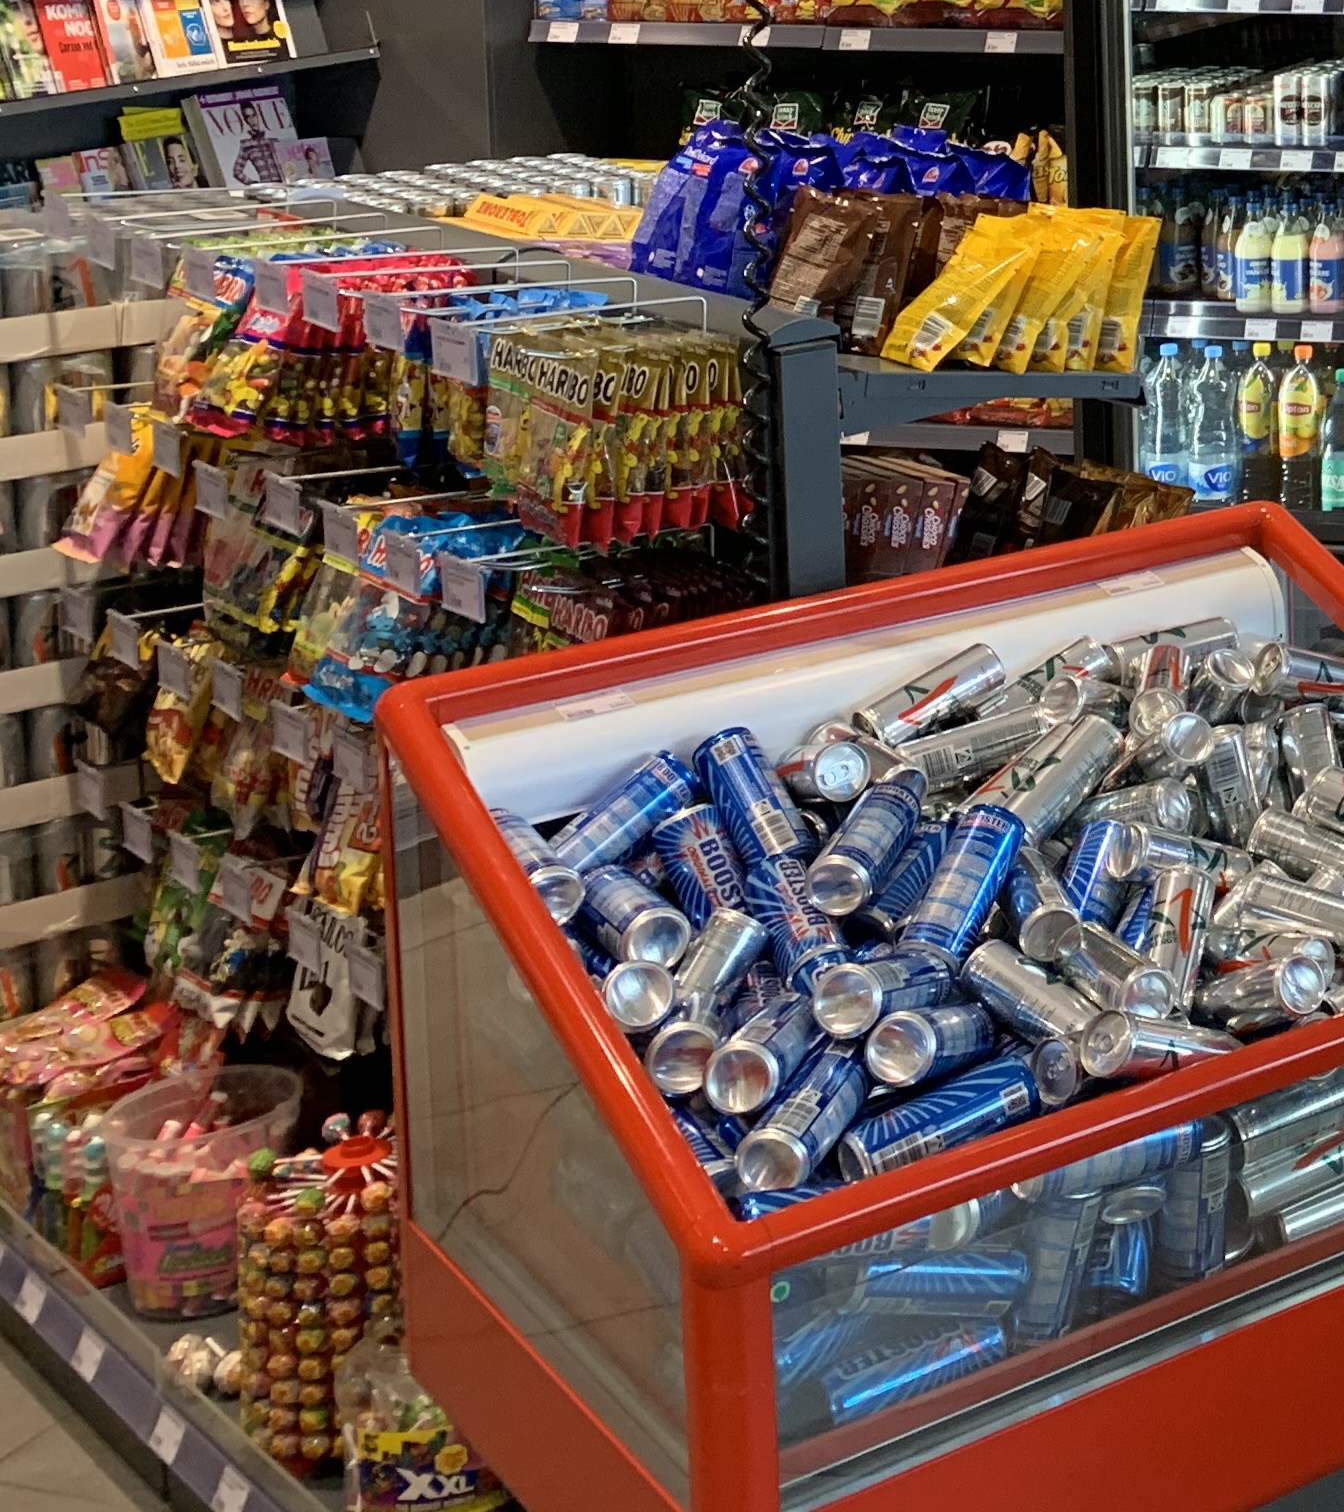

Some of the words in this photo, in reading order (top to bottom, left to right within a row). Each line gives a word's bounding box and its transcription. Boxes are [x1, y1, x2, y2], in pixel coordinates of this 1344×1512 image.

[206, 100, 293, 137] VOUE
[536, 356, 589, 408] HARIBO
[1151, 468, 1177, 483] VIO
[1207, 470, 1233, 484] VIO
[699, 833, 747, 916] BOOST
[397, 1466, 477, 1501] XXL
